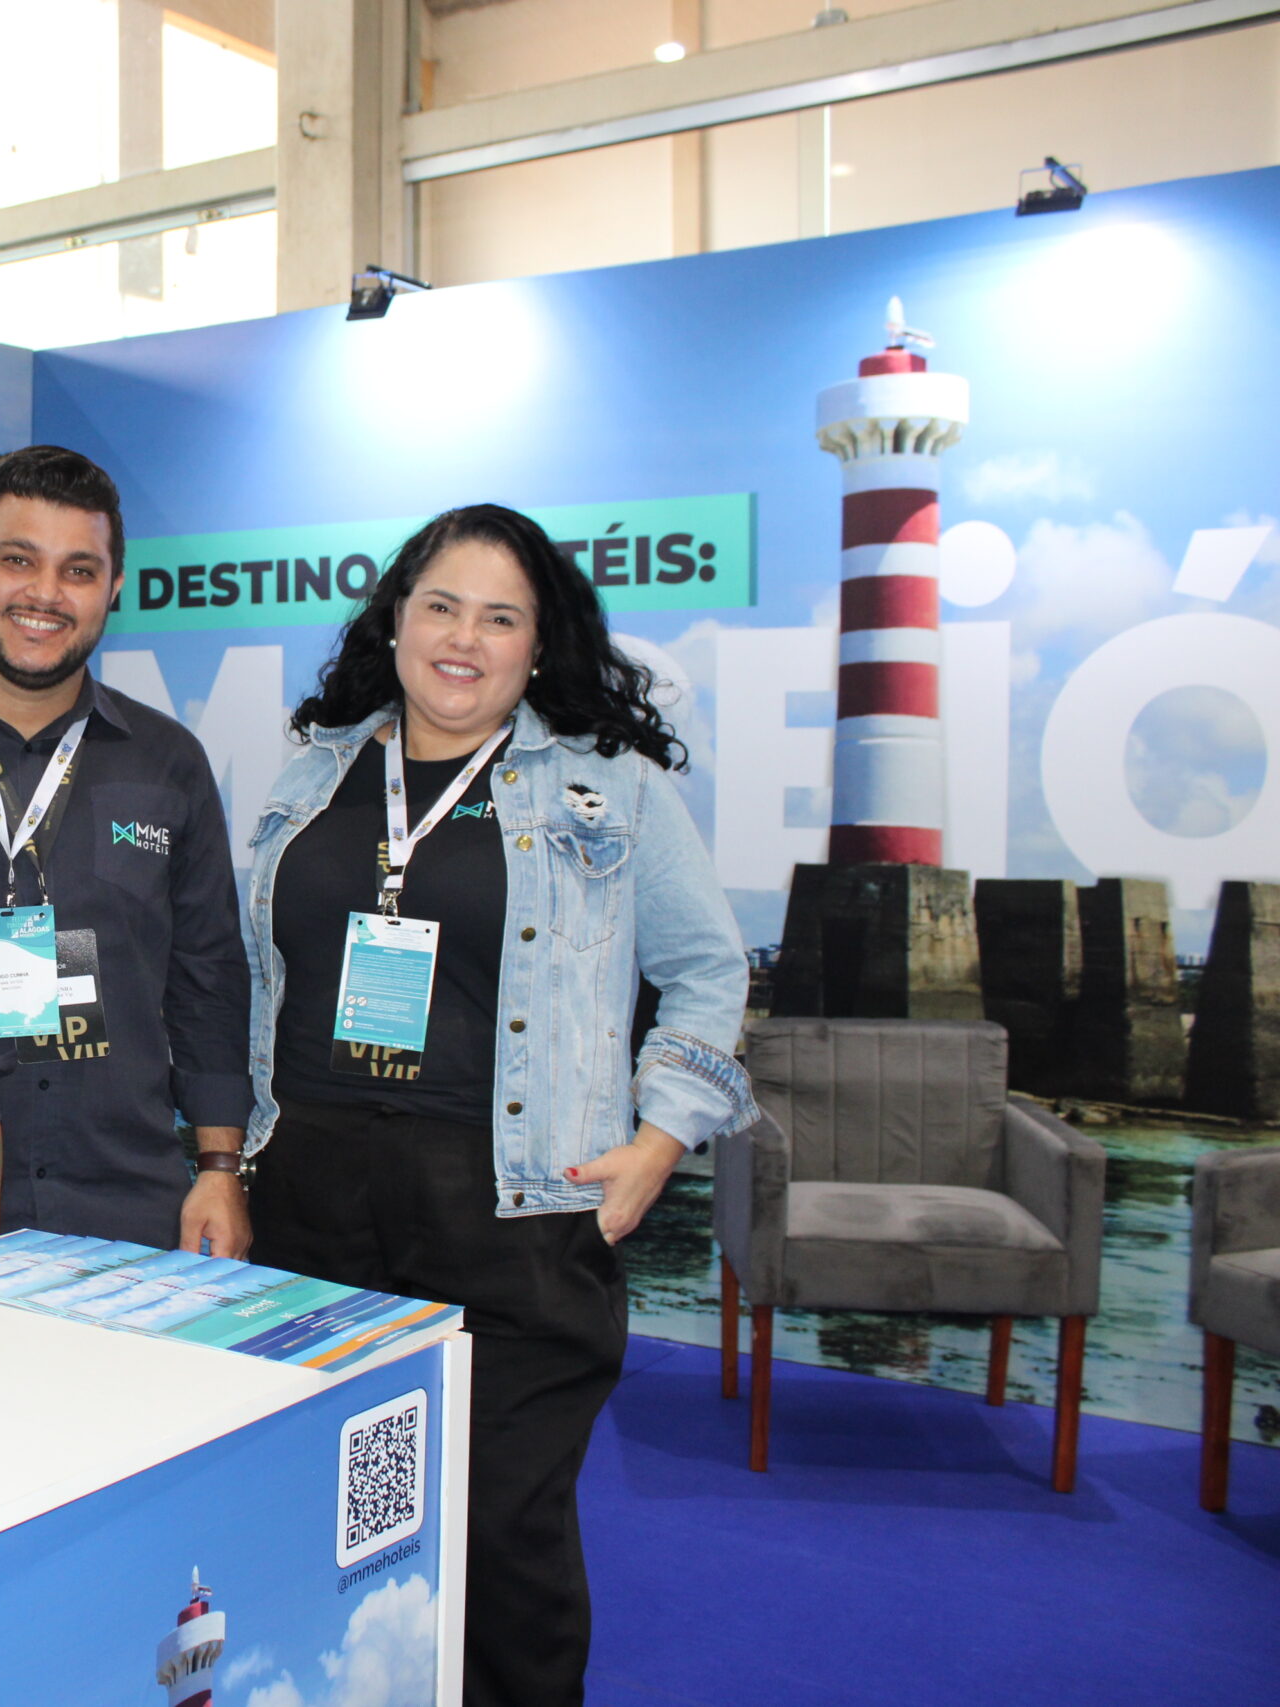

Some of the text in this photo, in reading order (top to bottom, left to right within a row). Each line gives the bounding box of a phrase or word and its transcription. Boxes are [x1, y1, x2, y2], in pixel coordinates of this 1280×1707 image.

[553, 522, 716, 587] TÉIS:
[135, 821, 171, 845] MME
[337, 1538, 421, 1594] @mmehoteis
